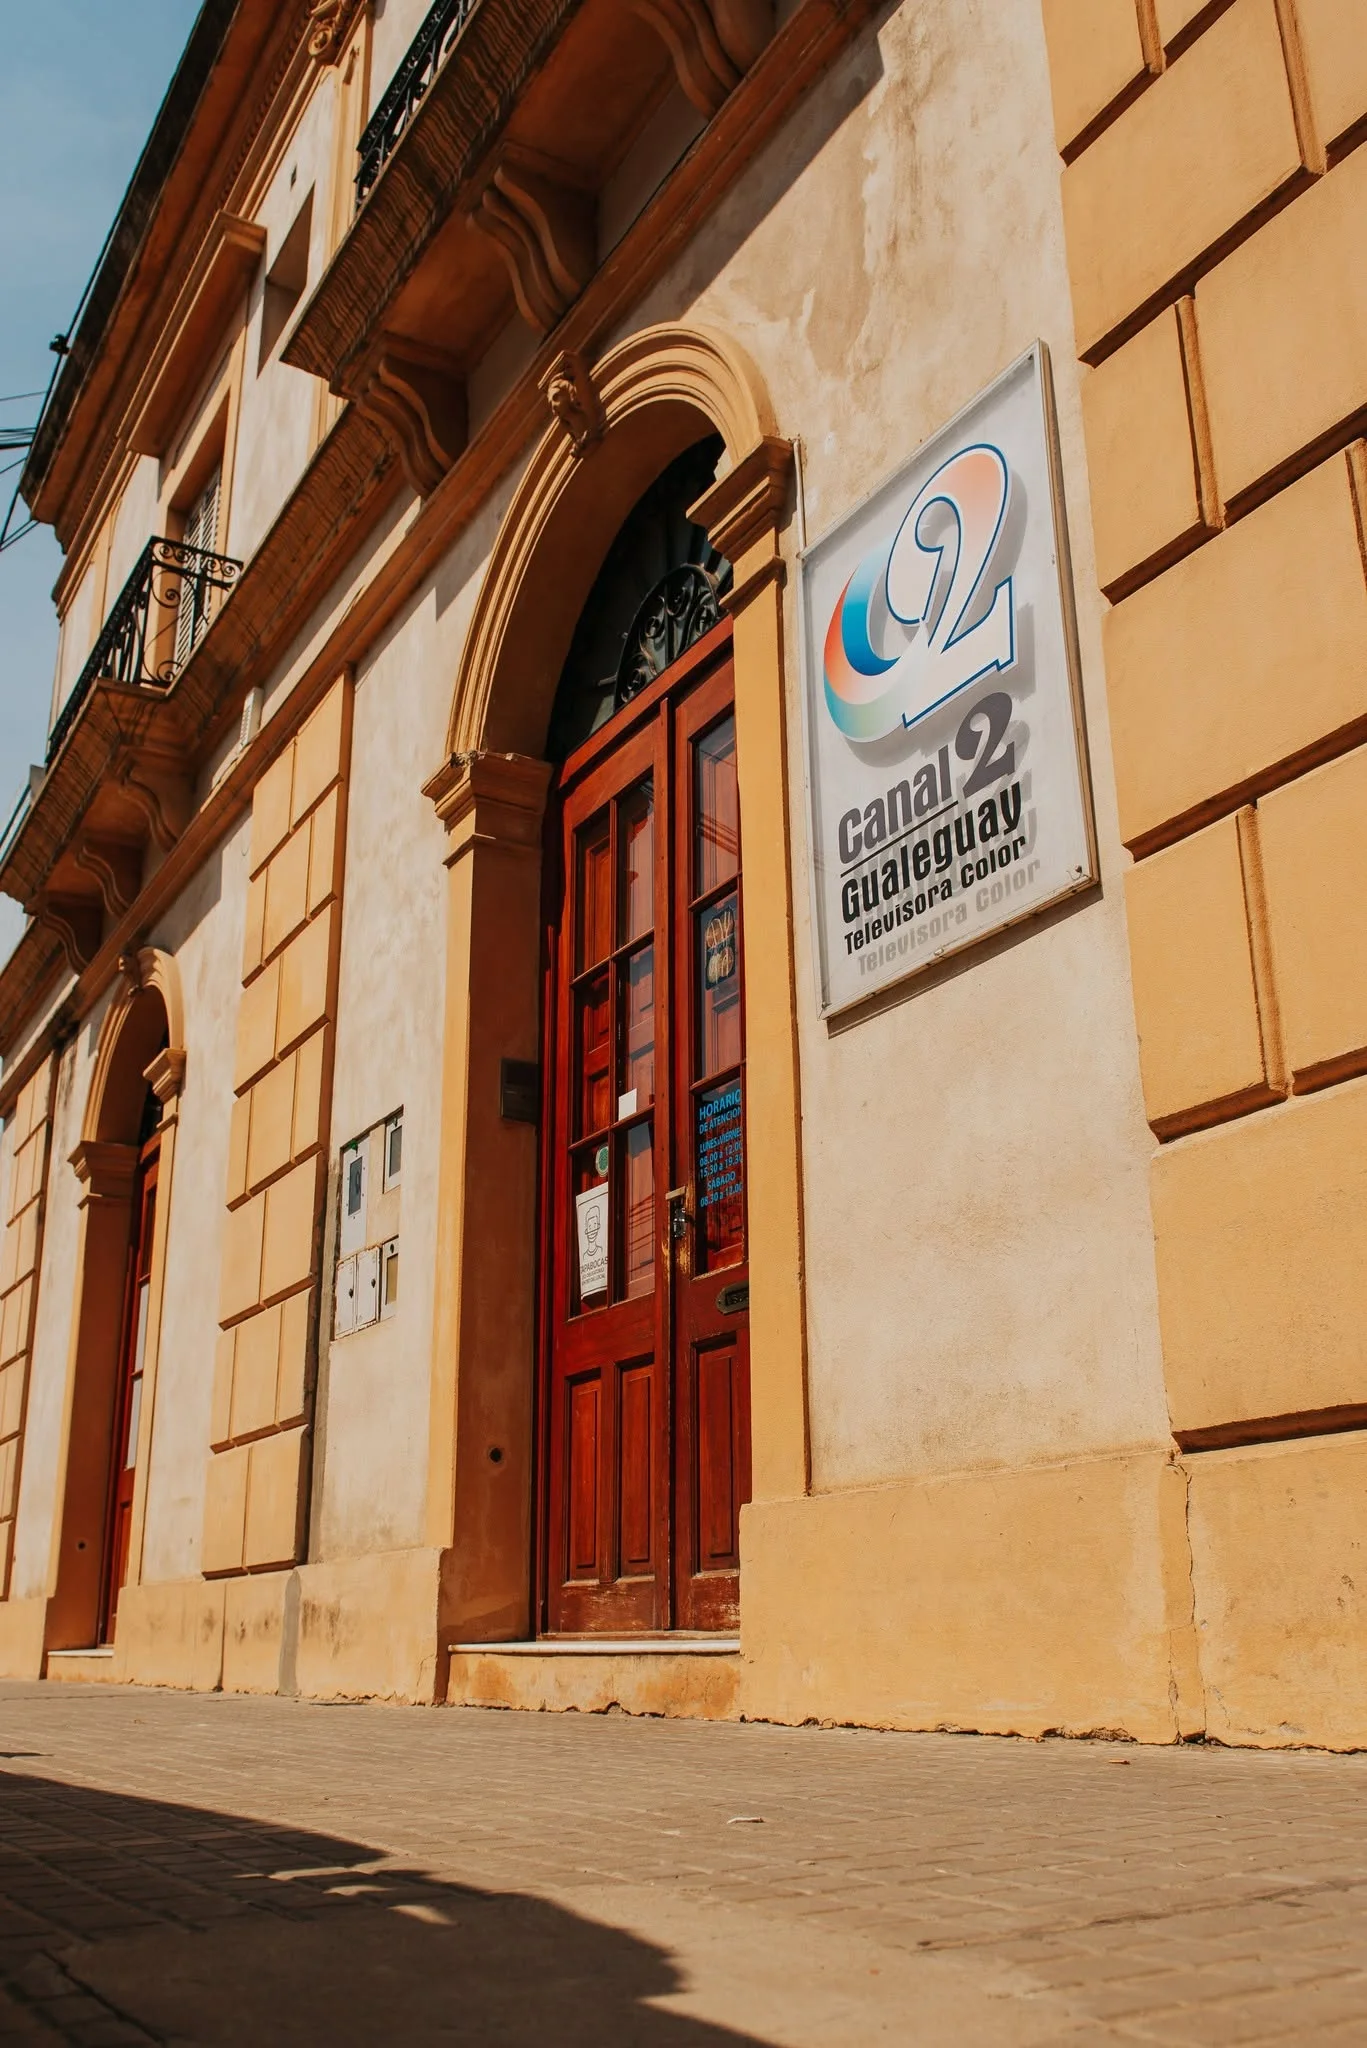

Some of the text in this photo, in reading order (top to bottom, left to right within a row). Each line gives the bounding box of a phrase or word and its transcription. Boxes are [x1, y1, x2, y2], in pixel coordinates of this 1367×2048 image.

[838, 692, 1016, 864] Canal 2
[840, 781, 1022, 924] Gualeguay
[844, 836, 1026, 955] Televisora Color
[699, 1122, 709, 1135] DE
[699, 1137, 717, 1154] LUNES
